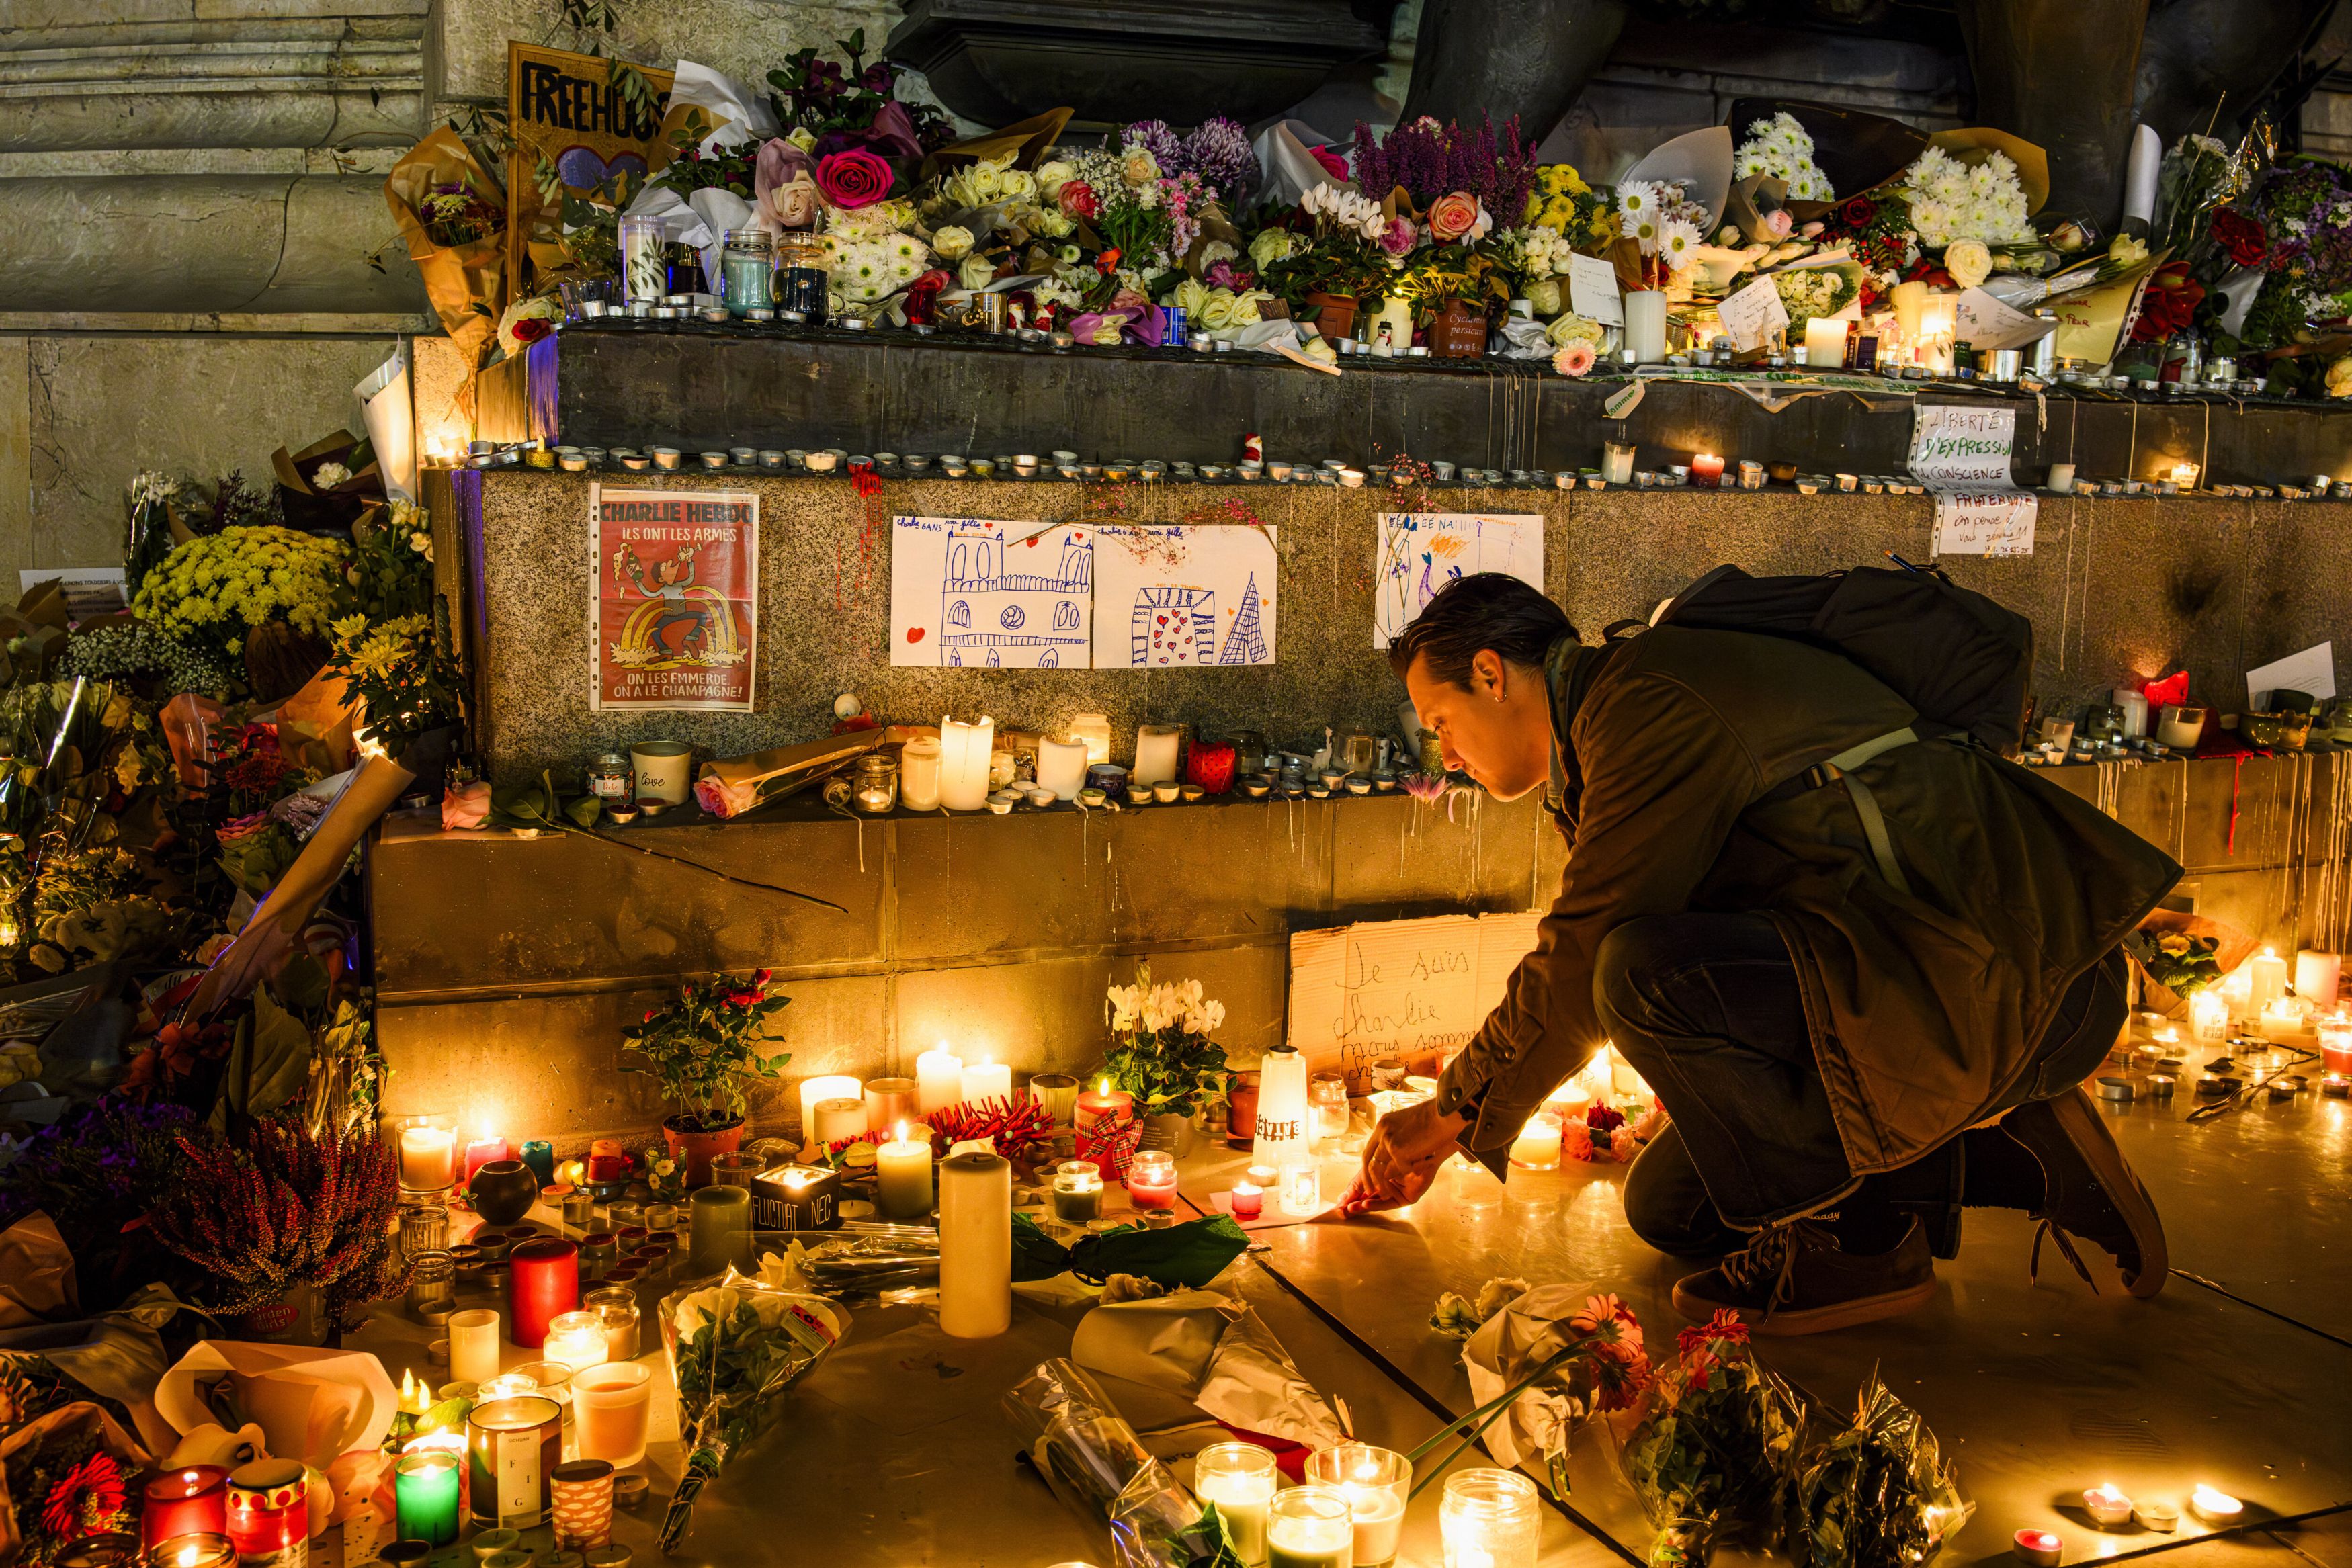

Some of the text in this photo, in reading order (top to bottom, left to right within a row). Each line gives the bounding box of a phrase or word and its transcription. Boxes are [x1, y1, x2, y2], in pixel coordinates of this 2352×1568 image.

[601, 502, 754, 524] CHARLIE HEBDO
[643, 527, 667, 541] ONT
[671, 527, 691, 541] LES
[694, 528, 737, 543] ARMES
[626, 672, 645, 685] ON
[648, 673, 667, 685] LES
[614, 686, 631, 699] ON
[634, 686, 642, 697] A
[645, 685, 658, 697] LE
[641, 772, 665, 787] love
[1335, 942, 1384, 990] Je
[752, 1194, 831, 1231] FLUCTUAT NEC
